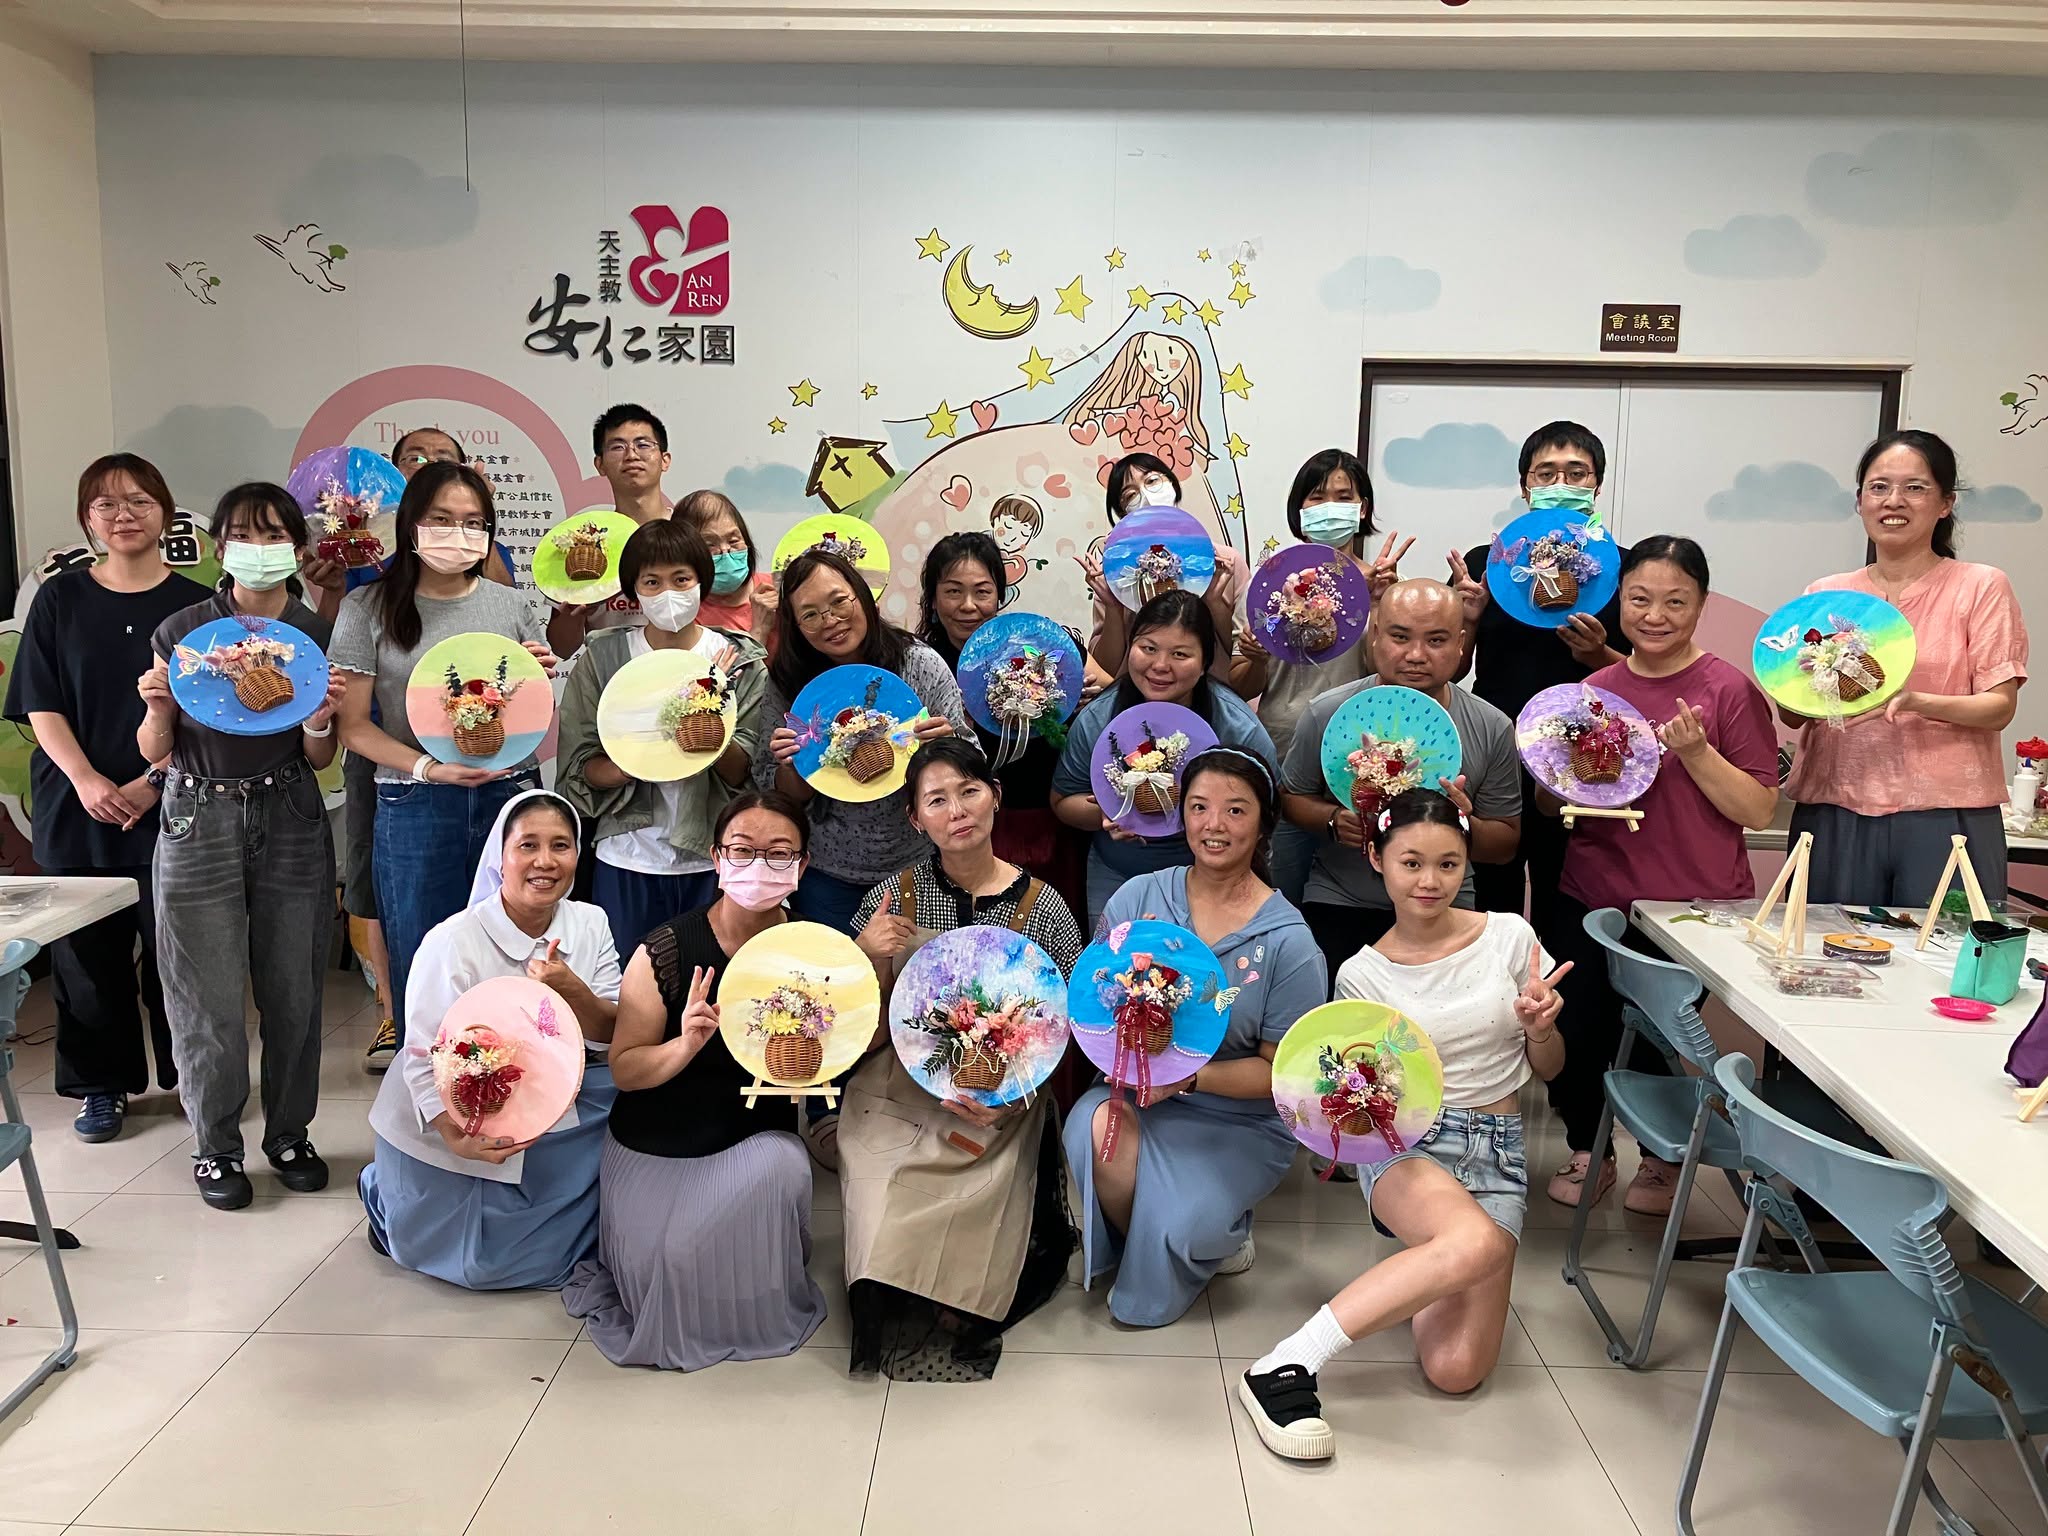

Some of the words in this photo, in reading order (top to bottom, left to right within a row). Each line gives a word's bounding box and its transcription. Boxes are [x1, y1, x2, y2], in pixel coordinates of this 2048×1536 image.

[599, 230, 621, 303] 天主教
[687, 273, 712, 289] AN
[687, 291, 722, 308] REN
[524, 272, 736, 368] 安仁家園
[1608, 312, 1676, 331] 會議室
[1605, 332, 1646, 344] Meeting
[1647, 333, 1676, 343] Room
[456, 428, 501, 446] you
[491, 491, 553, 502] 育公益信託
[126, 625, 133, 634] R
